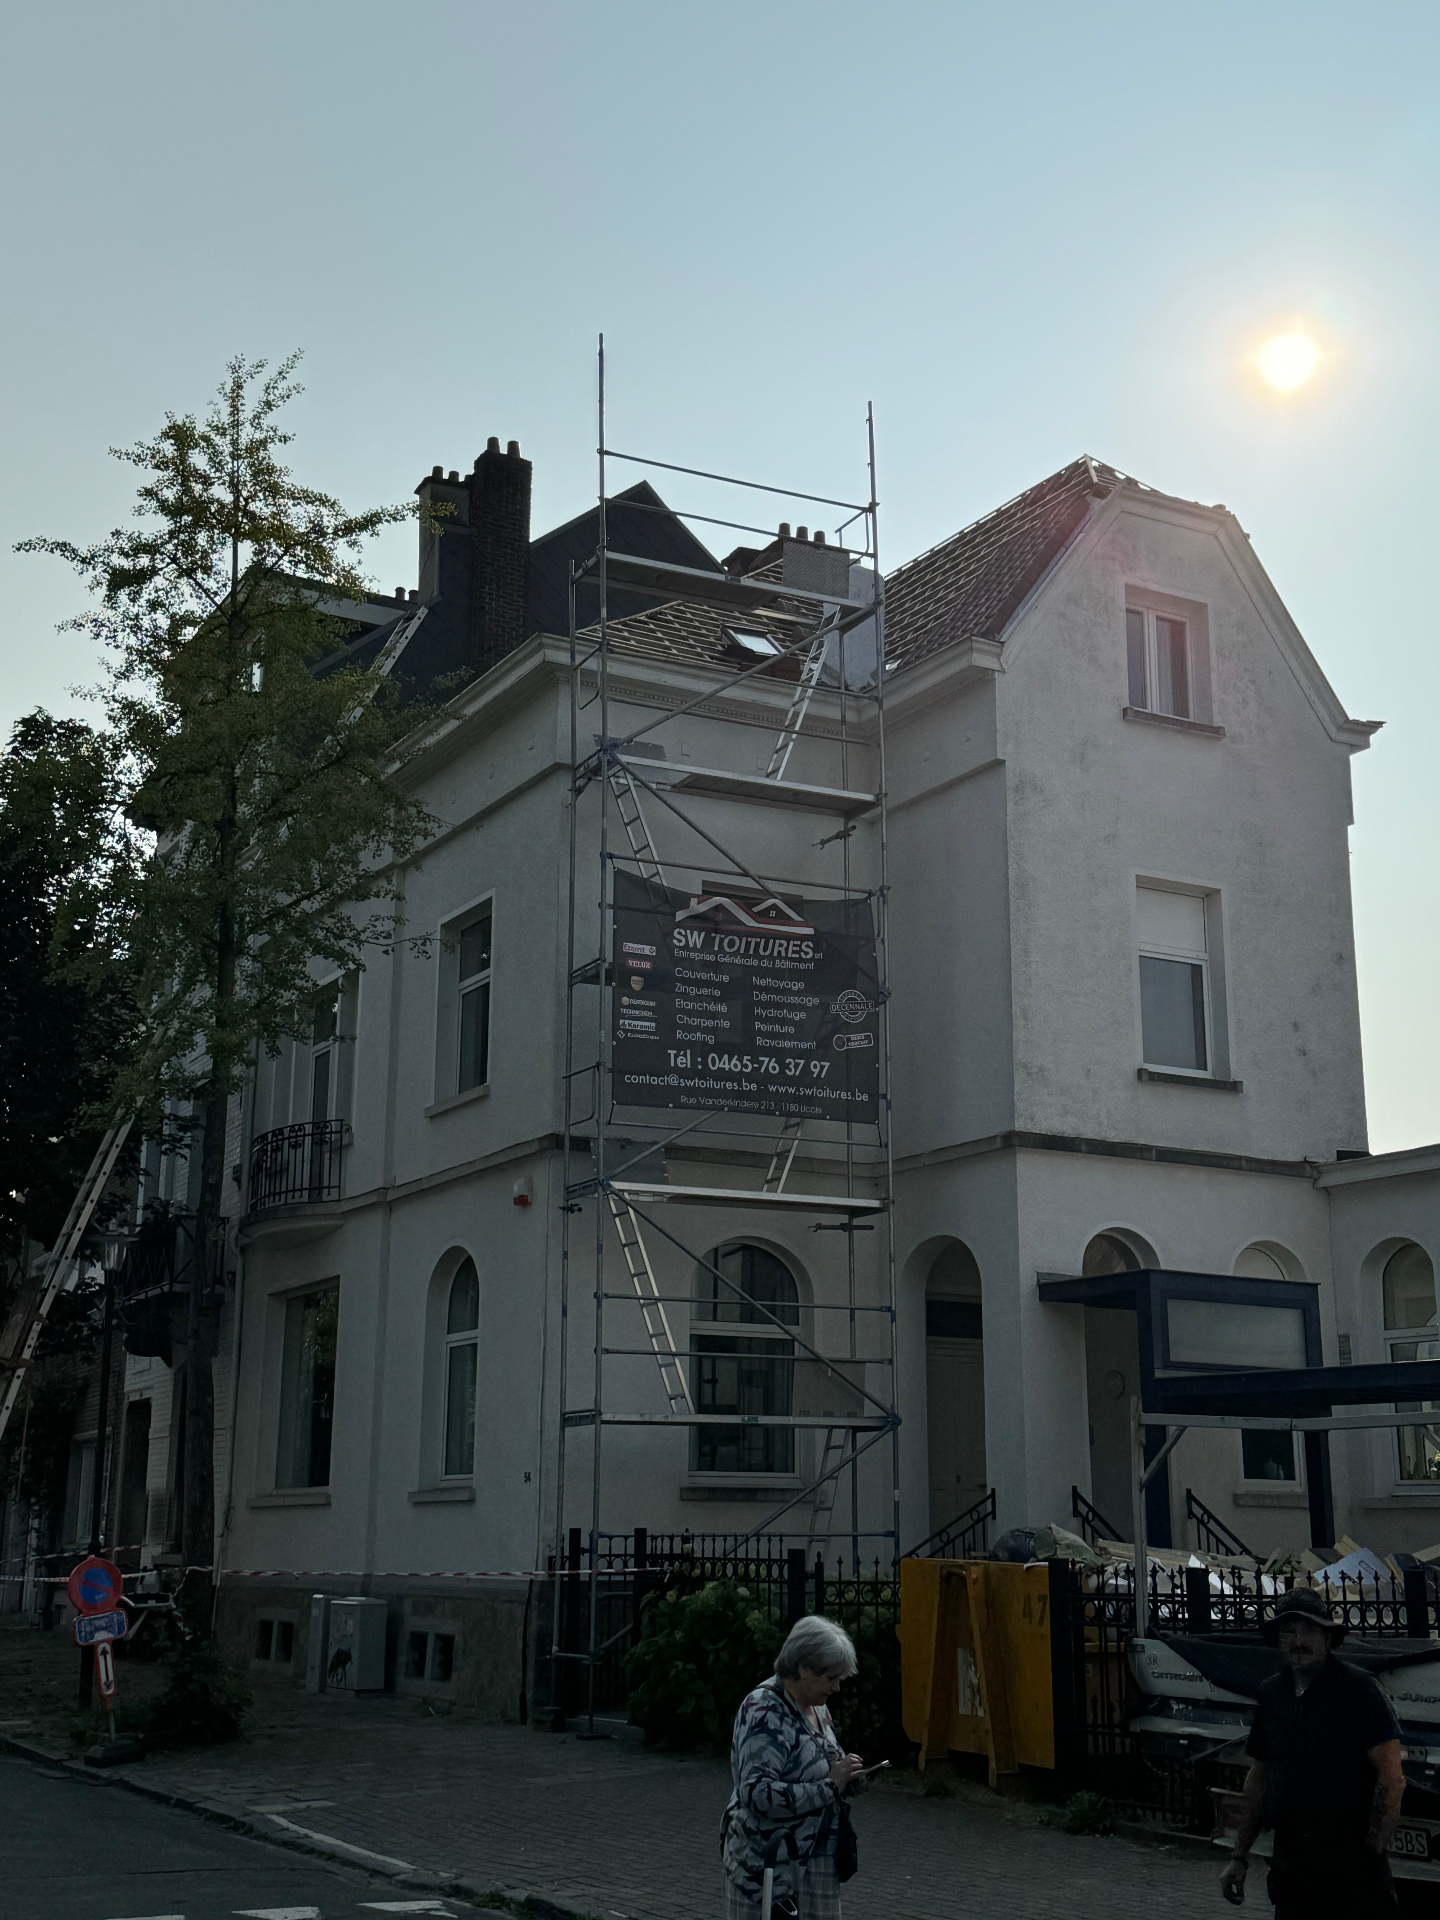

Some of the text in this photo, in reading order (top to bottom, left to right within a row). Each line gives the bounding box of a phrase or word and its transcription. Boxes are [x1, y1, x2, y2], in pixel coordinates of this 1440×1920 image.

[672, 928, 705, 949] SW
[711, 932, 814, 959] TOITURES
[628, 959, 651, 969] VELUX
[674, 949, 814, 970] Entreprise Générale du Bâtiment
[674, 967, 730, 983] Couverture
[674, 983, 721, 997] Zinguerie
[752, 976, 805, 991] Nettoyage
[675, 998, 728, 1013] Etanchéité
[753, 991, 820, 1007] Démoussage
[754, 1007, 807, 1021] Hydrofuge
[831, 1002, 873, 1012] DECENNALE
[676, 1014, 730, 1028] Charpente
[755, 1021, 795, 1034] Peinture
[676, 1030, 715, 1045] Roofing
[756, 1037, 817, 1050] Ravalement
[667, 1049, 691, 1069] Tél
[708, 1053, 780, 1075] 0465-76
[785, 1058, 806, 1077] 37
[810, 1060, 831, 1079] 97
[624, 1074, 758, 1091] contact@swtoitures.be
[767, 1083, 869, 1102] www.swtoitures.be
[680, 1095, 697, 1104] Rue
[698, 1096, 759, 1109] Vanderkindere
[760, 1100, 775, 1110] 213
[782, 1102, 799, 1112] 1180
[800, 1105, 823, 1114] Uccle
[1022, 1592, 1048, 1627] 47
[1388, 1830, 1426, 1855] 5BS
